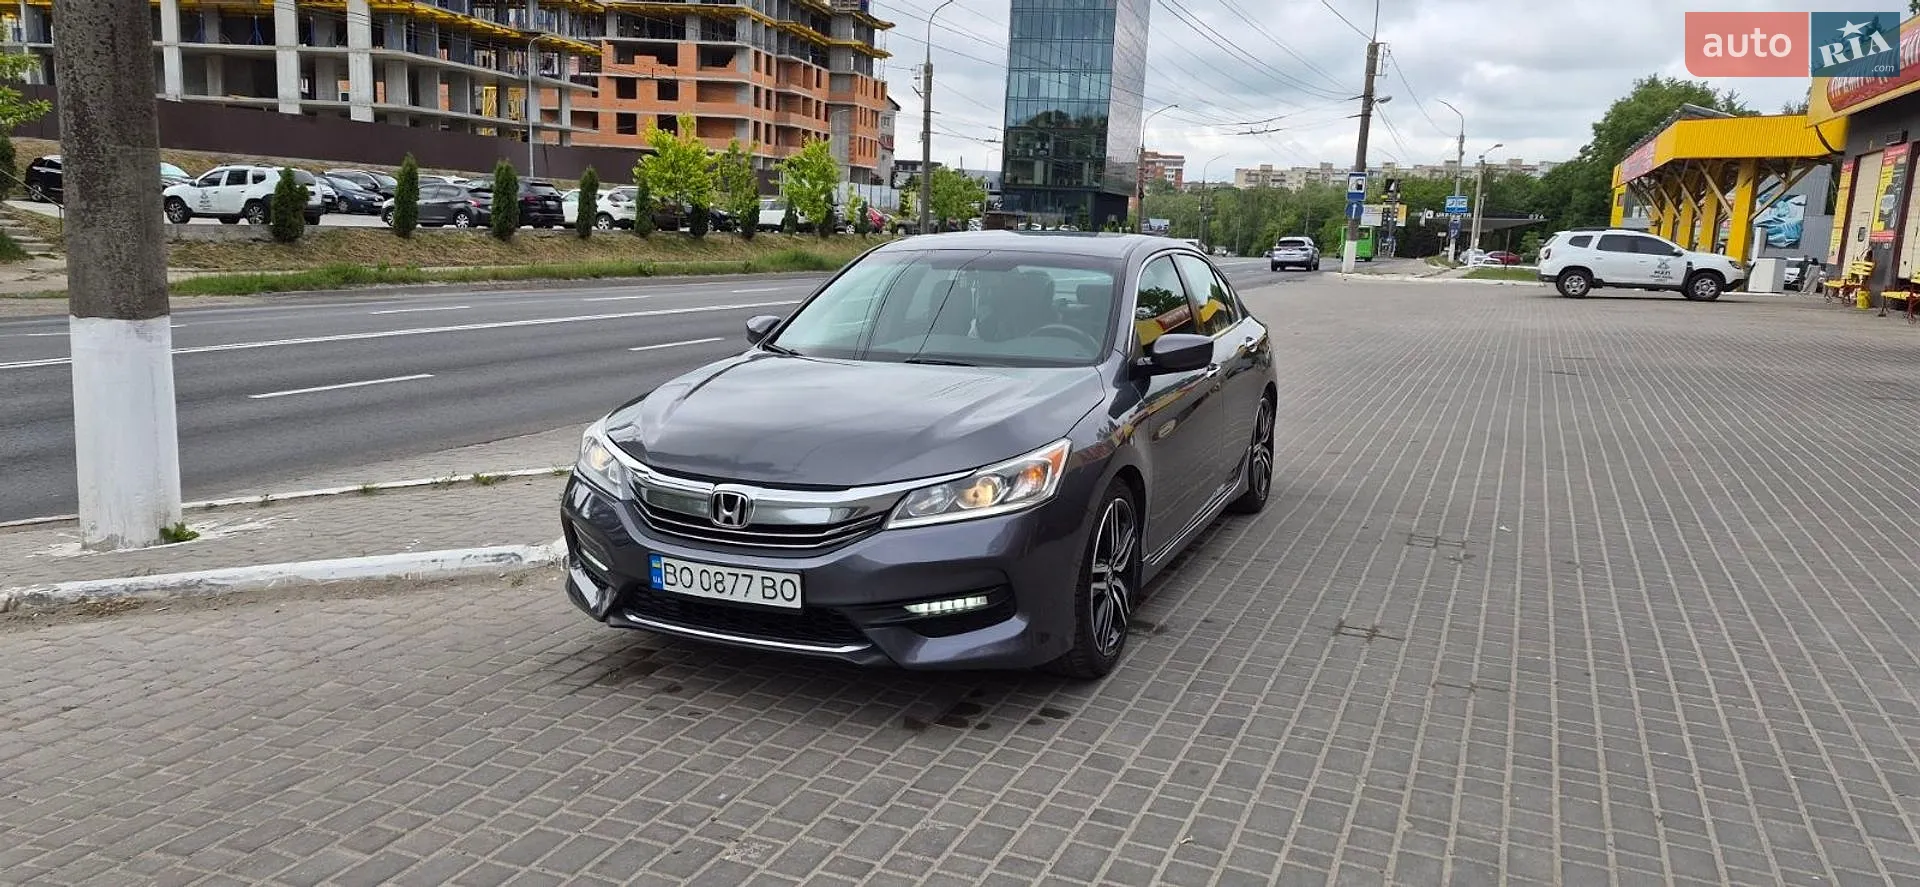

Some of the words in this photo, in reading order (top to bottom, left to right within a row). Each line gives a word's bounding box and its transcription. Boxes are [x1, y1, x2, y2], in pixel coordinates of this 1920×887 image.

[652, 575, 662, 585] UA
[663, 562, 694, 589] BO
[699, 569, 754, 598] 0877
[760, 575, 797, 603] BO
